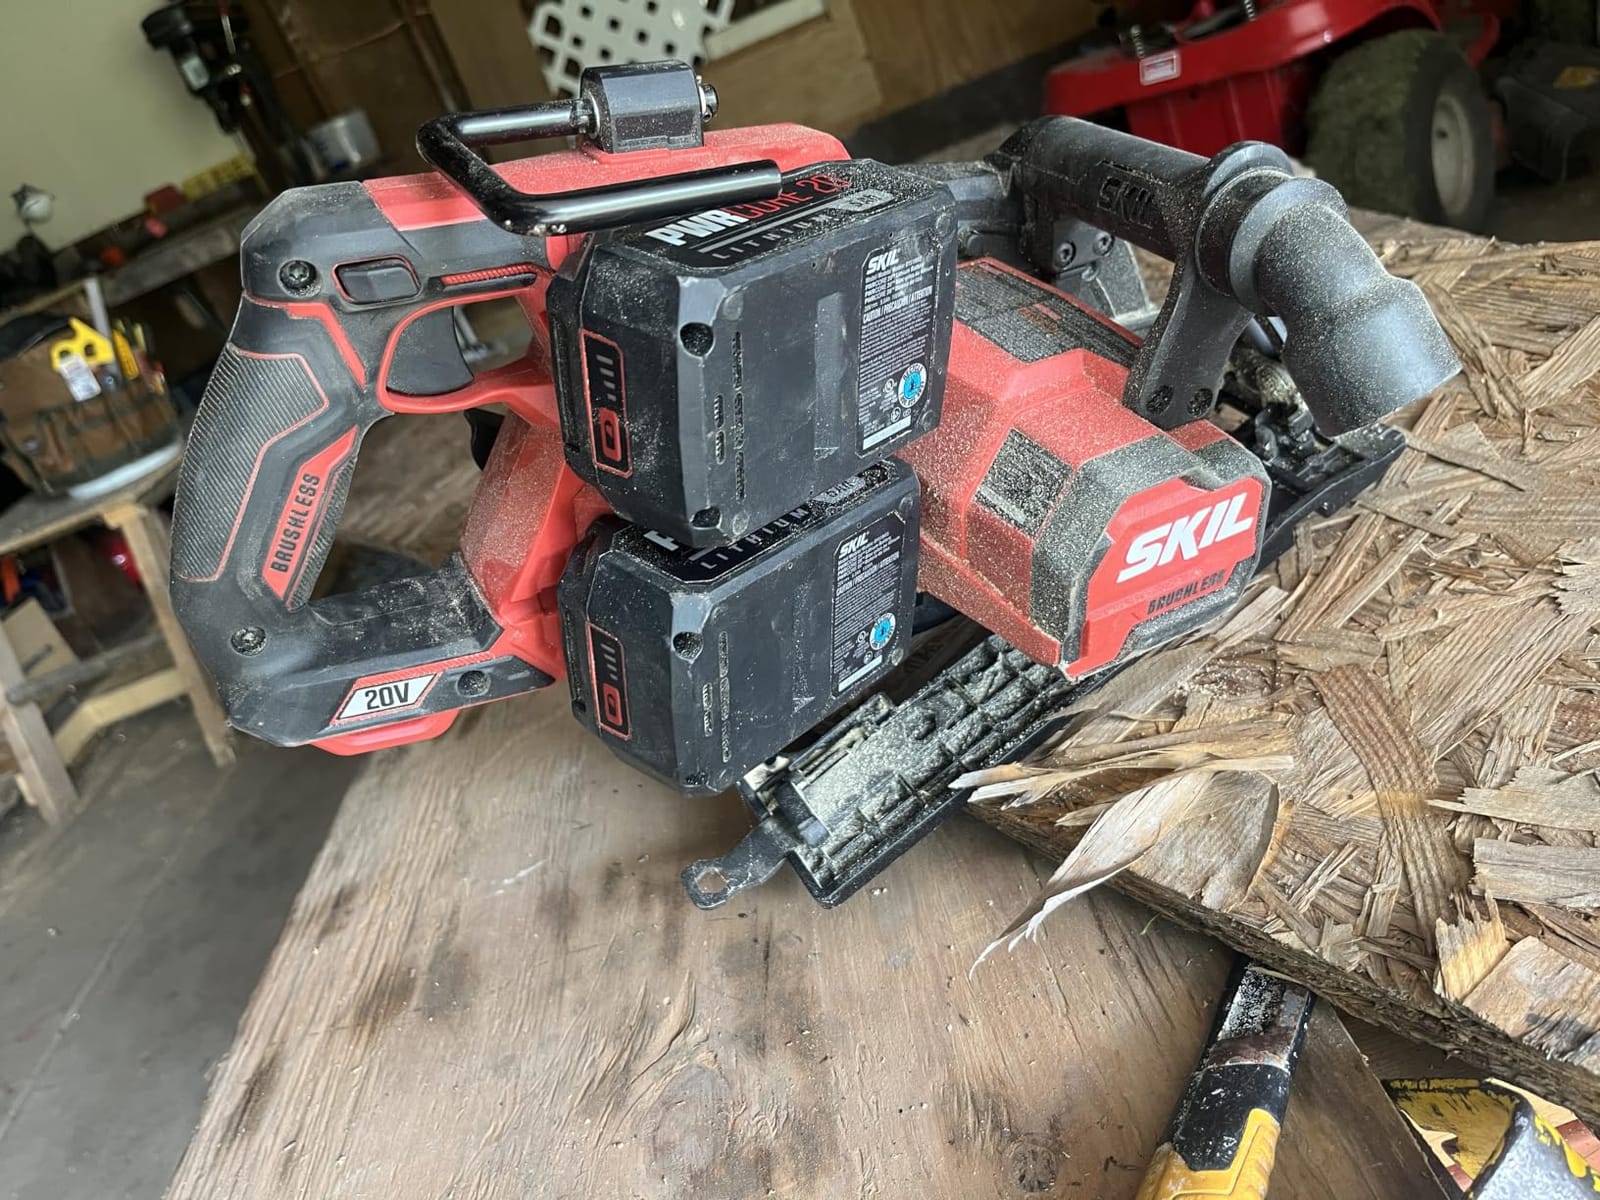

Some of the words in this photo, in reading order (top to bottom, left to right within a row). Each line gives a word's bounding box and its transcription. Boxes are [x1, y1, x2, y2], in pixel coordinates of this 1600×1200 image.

[1098, 176, 1154, 229] SKIL
[866, 248, 900, 275] SKIL
[270, 473, 320, 573] BRUSHLESS
[701, 508, 811, 570] LITHIUM
[838, 532, 868, 559] SKIL
[1116, 492, 1254, 584] SKIL
[1147, 569, 1226, 615] BRUSHLESS
[364, 682, 410, 711] 20V
